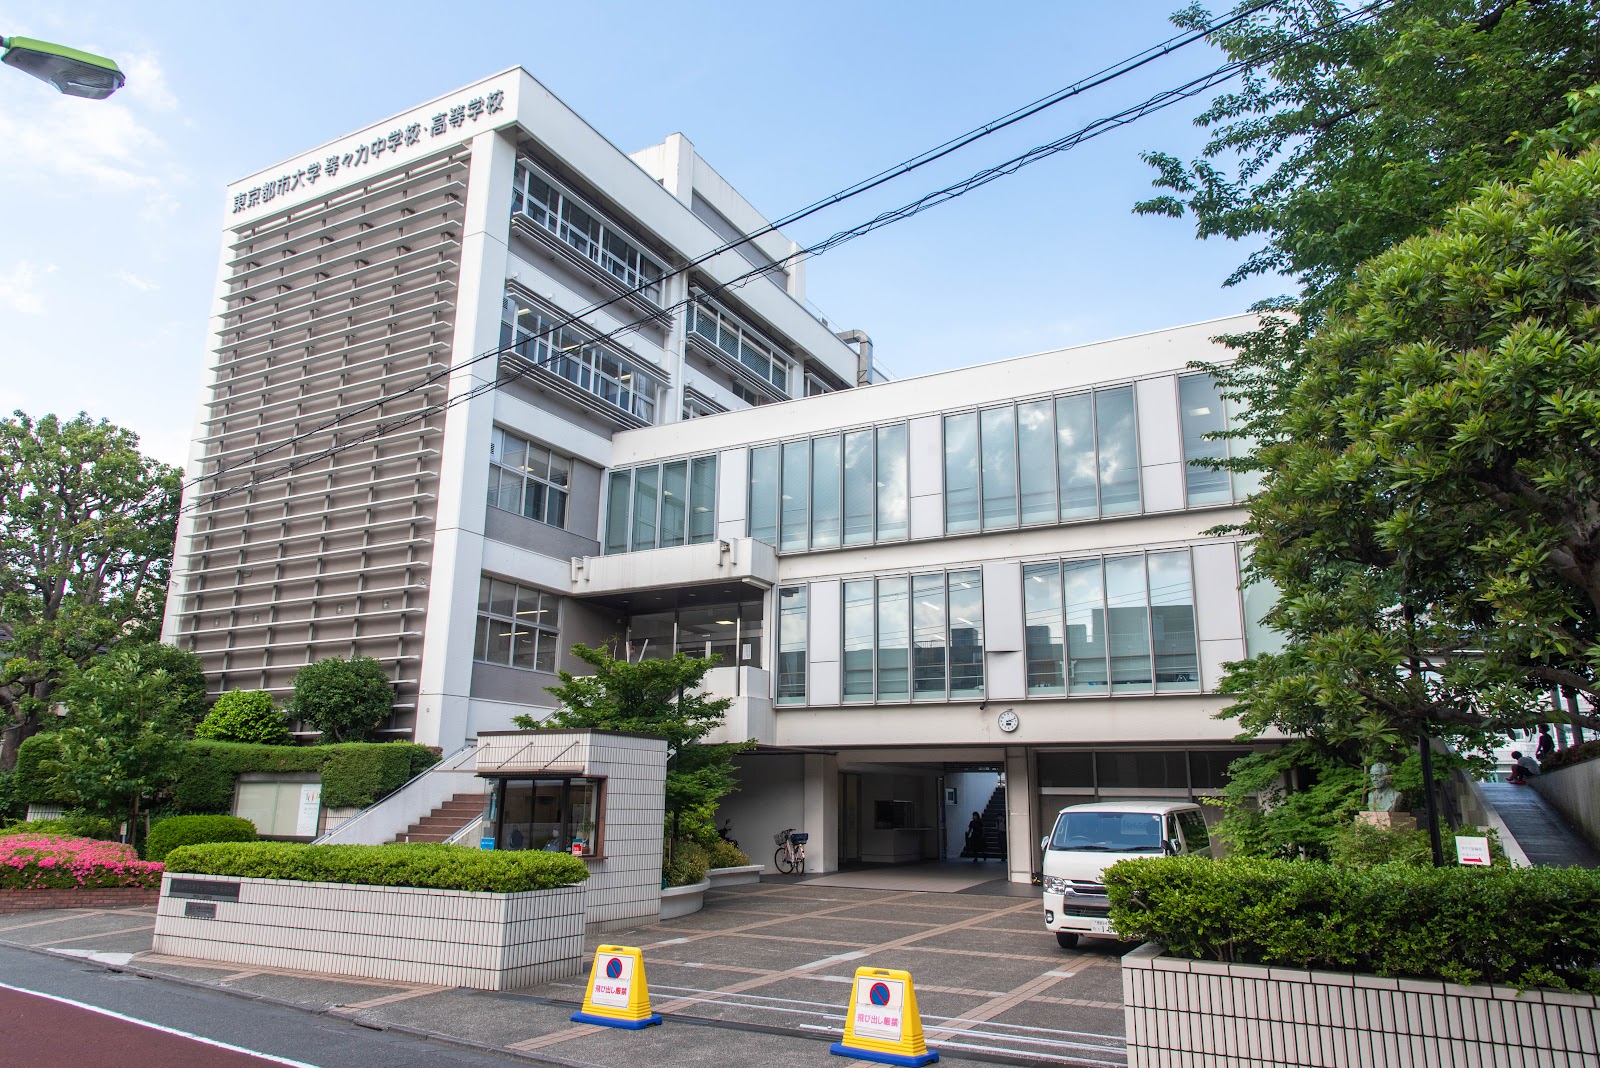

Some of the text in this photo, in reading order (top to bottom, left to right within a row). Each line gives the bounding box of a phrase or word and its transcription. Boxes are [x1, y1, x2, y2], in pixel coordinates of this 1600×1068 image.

[595, 984, 628, 996] 飛び出し厳禁
[857, 1013, 899, 1027] 飛び出し厳禁
